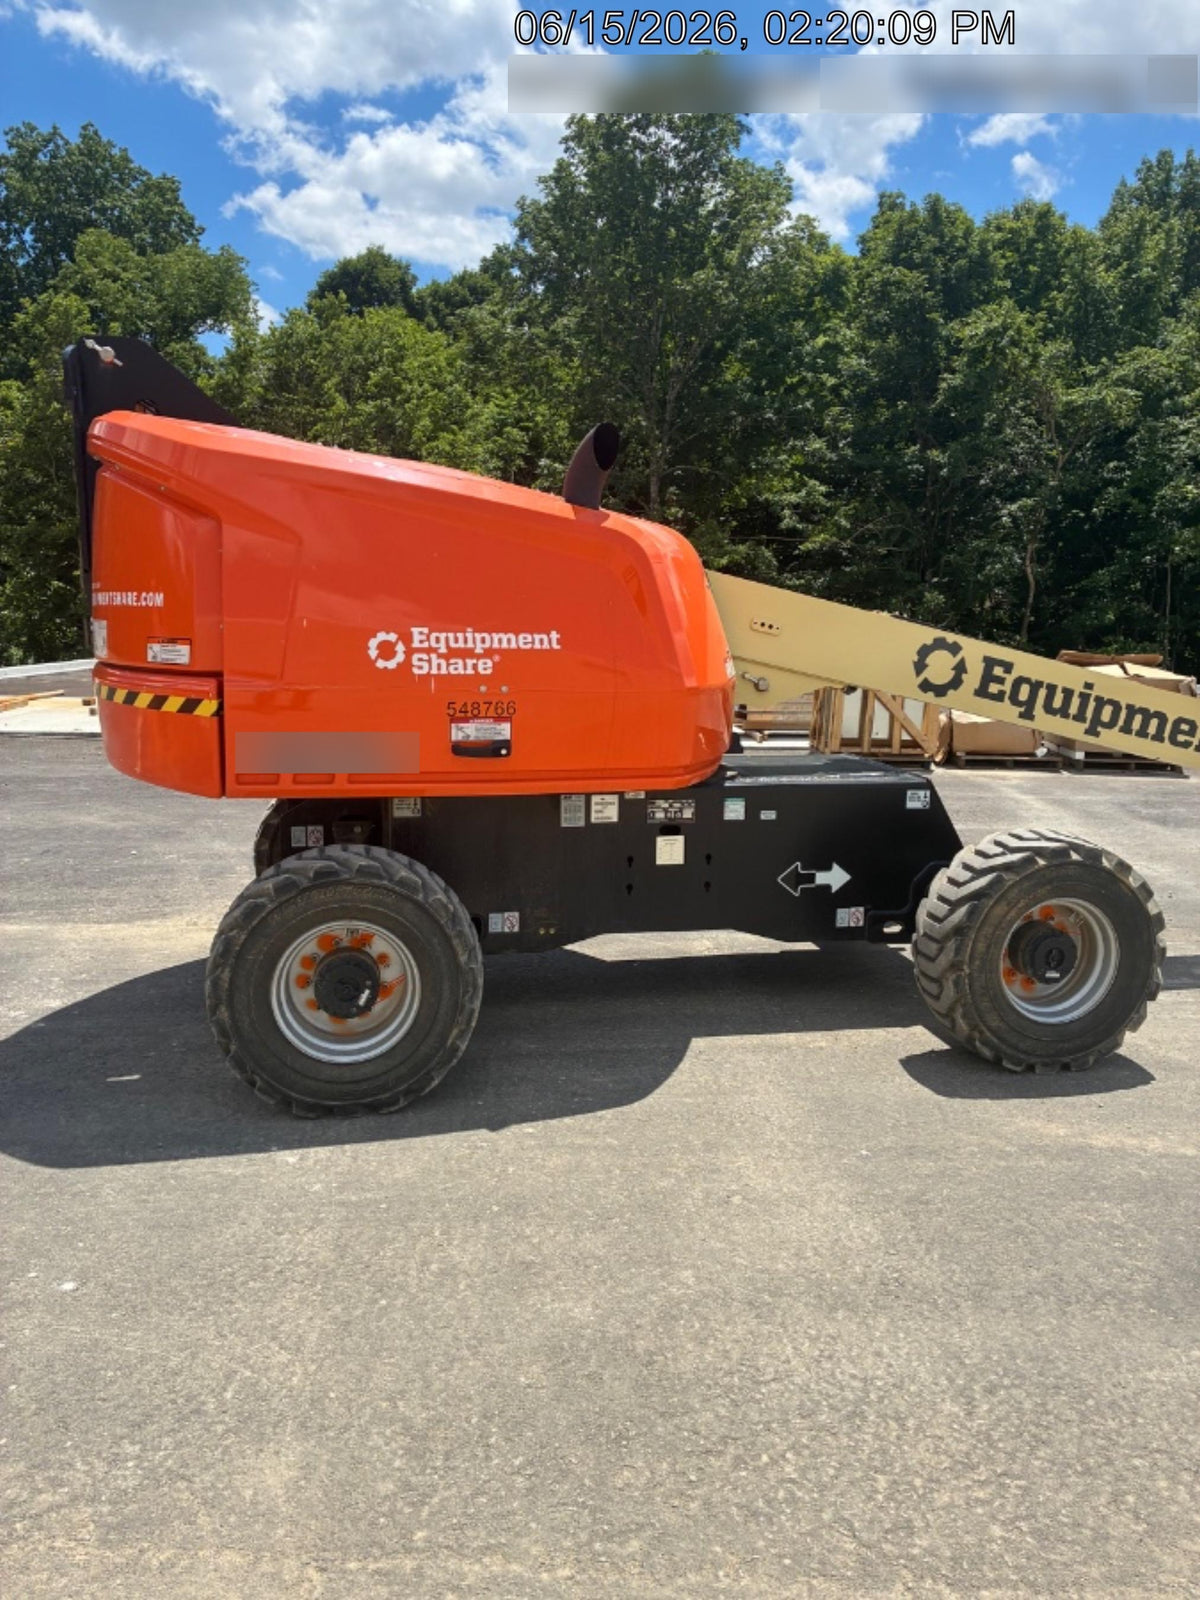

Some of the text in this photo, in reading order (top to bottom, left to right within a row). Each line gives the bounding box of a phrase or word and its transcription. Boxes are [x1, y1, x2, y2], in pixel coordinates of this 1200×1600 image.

[410, 627, 562, 653] Equipment
[446, 700, 517, 717] 548766
[973, 655, 1200, 753] Equipme
